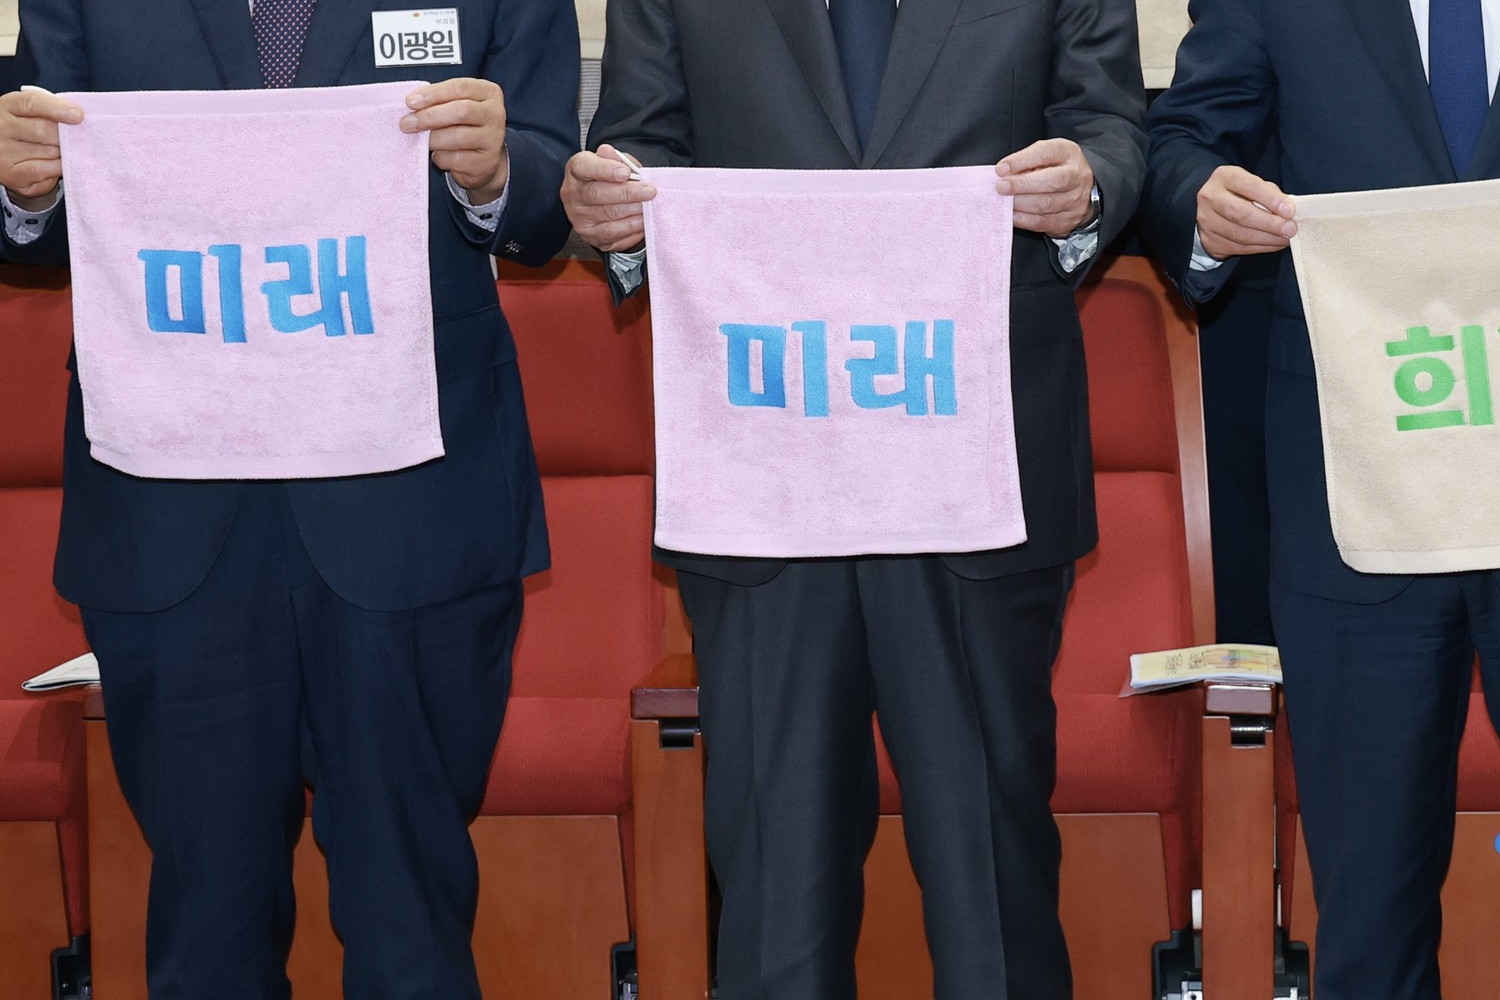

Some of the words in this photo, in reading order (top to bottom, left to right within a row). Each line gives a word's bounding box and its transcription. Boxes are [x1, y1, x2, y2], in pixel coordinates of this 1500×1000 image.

[379, 30, 455, 61] 이광일
[137, 235, 375, 344] 미래
[719, 319, 958, 418] 미래
